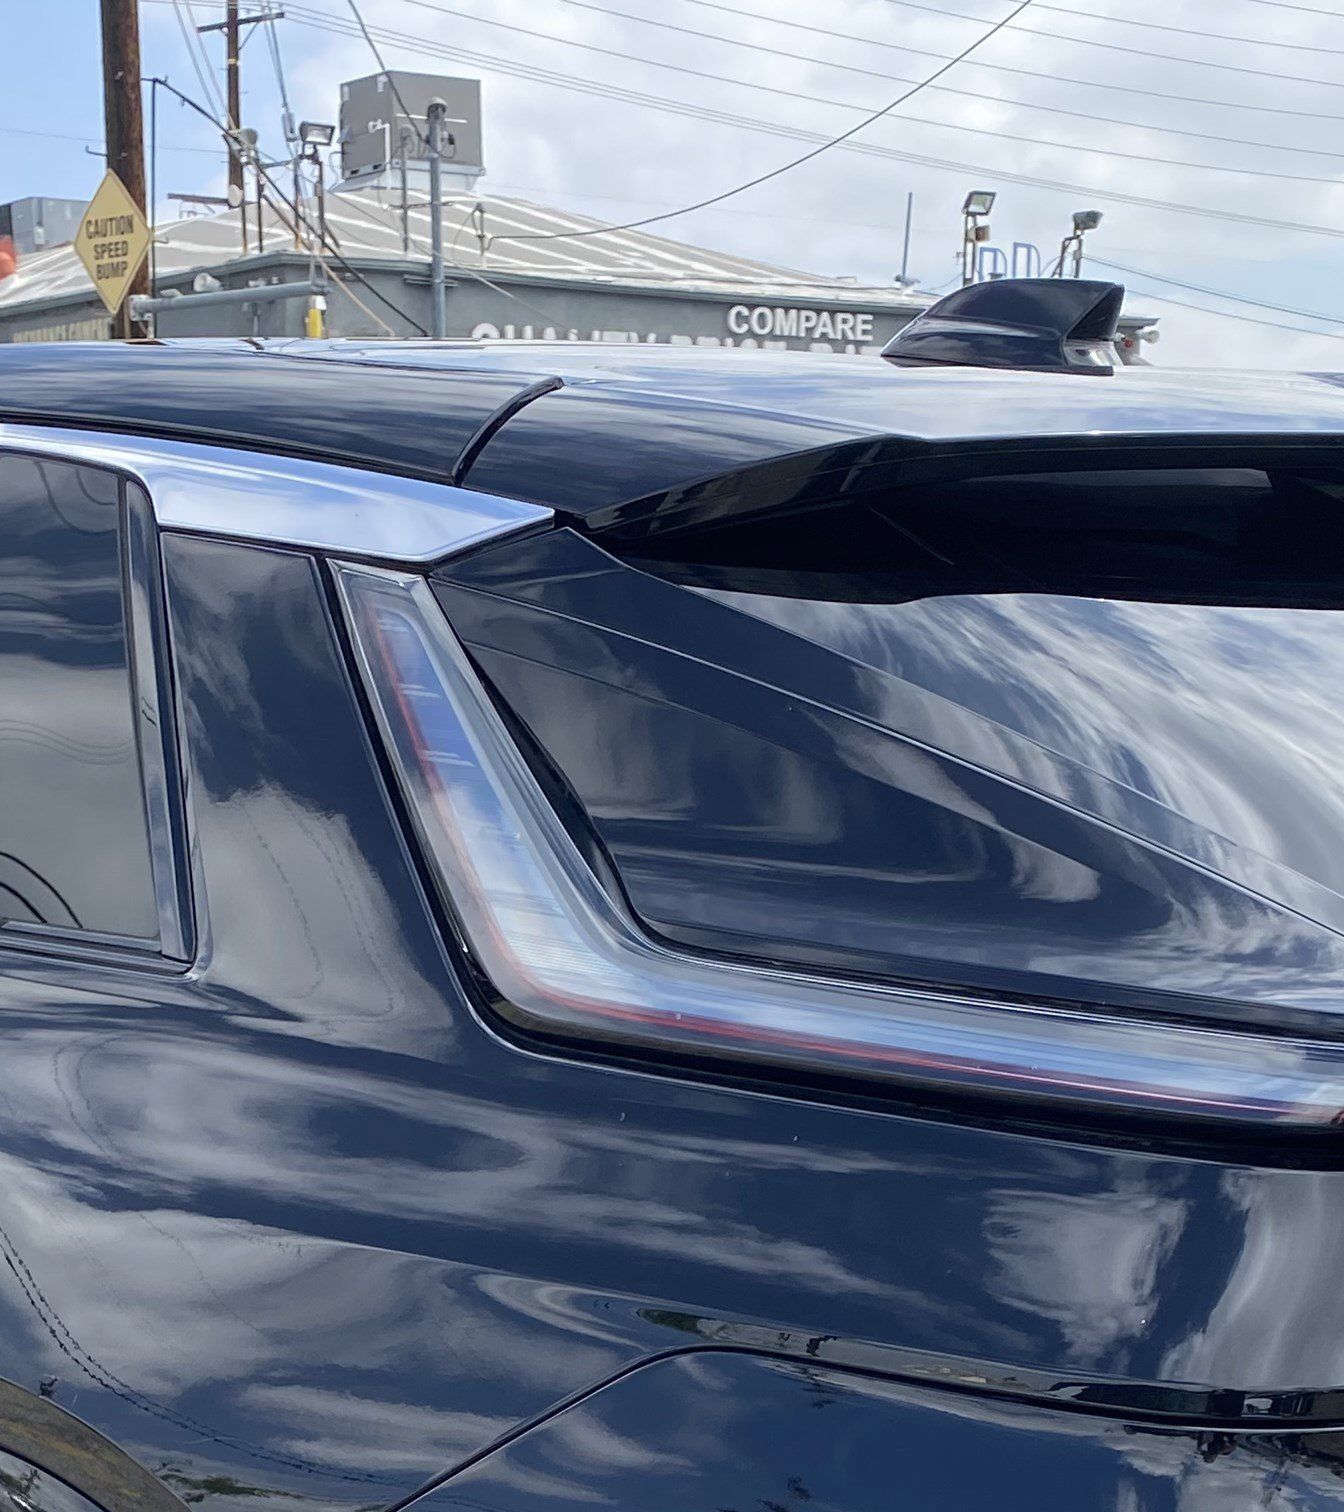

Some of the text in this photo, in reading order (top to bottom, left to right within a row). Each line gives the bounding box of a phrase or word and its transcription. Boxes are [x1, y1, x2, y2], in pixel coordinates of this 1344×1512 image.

[85, 214, 134, 240] CAUTION
[93, 240, 129, 261] SPEED
[96, 260, 128, 281] BUMP
[727, 304, 874, 342] COMPARE
